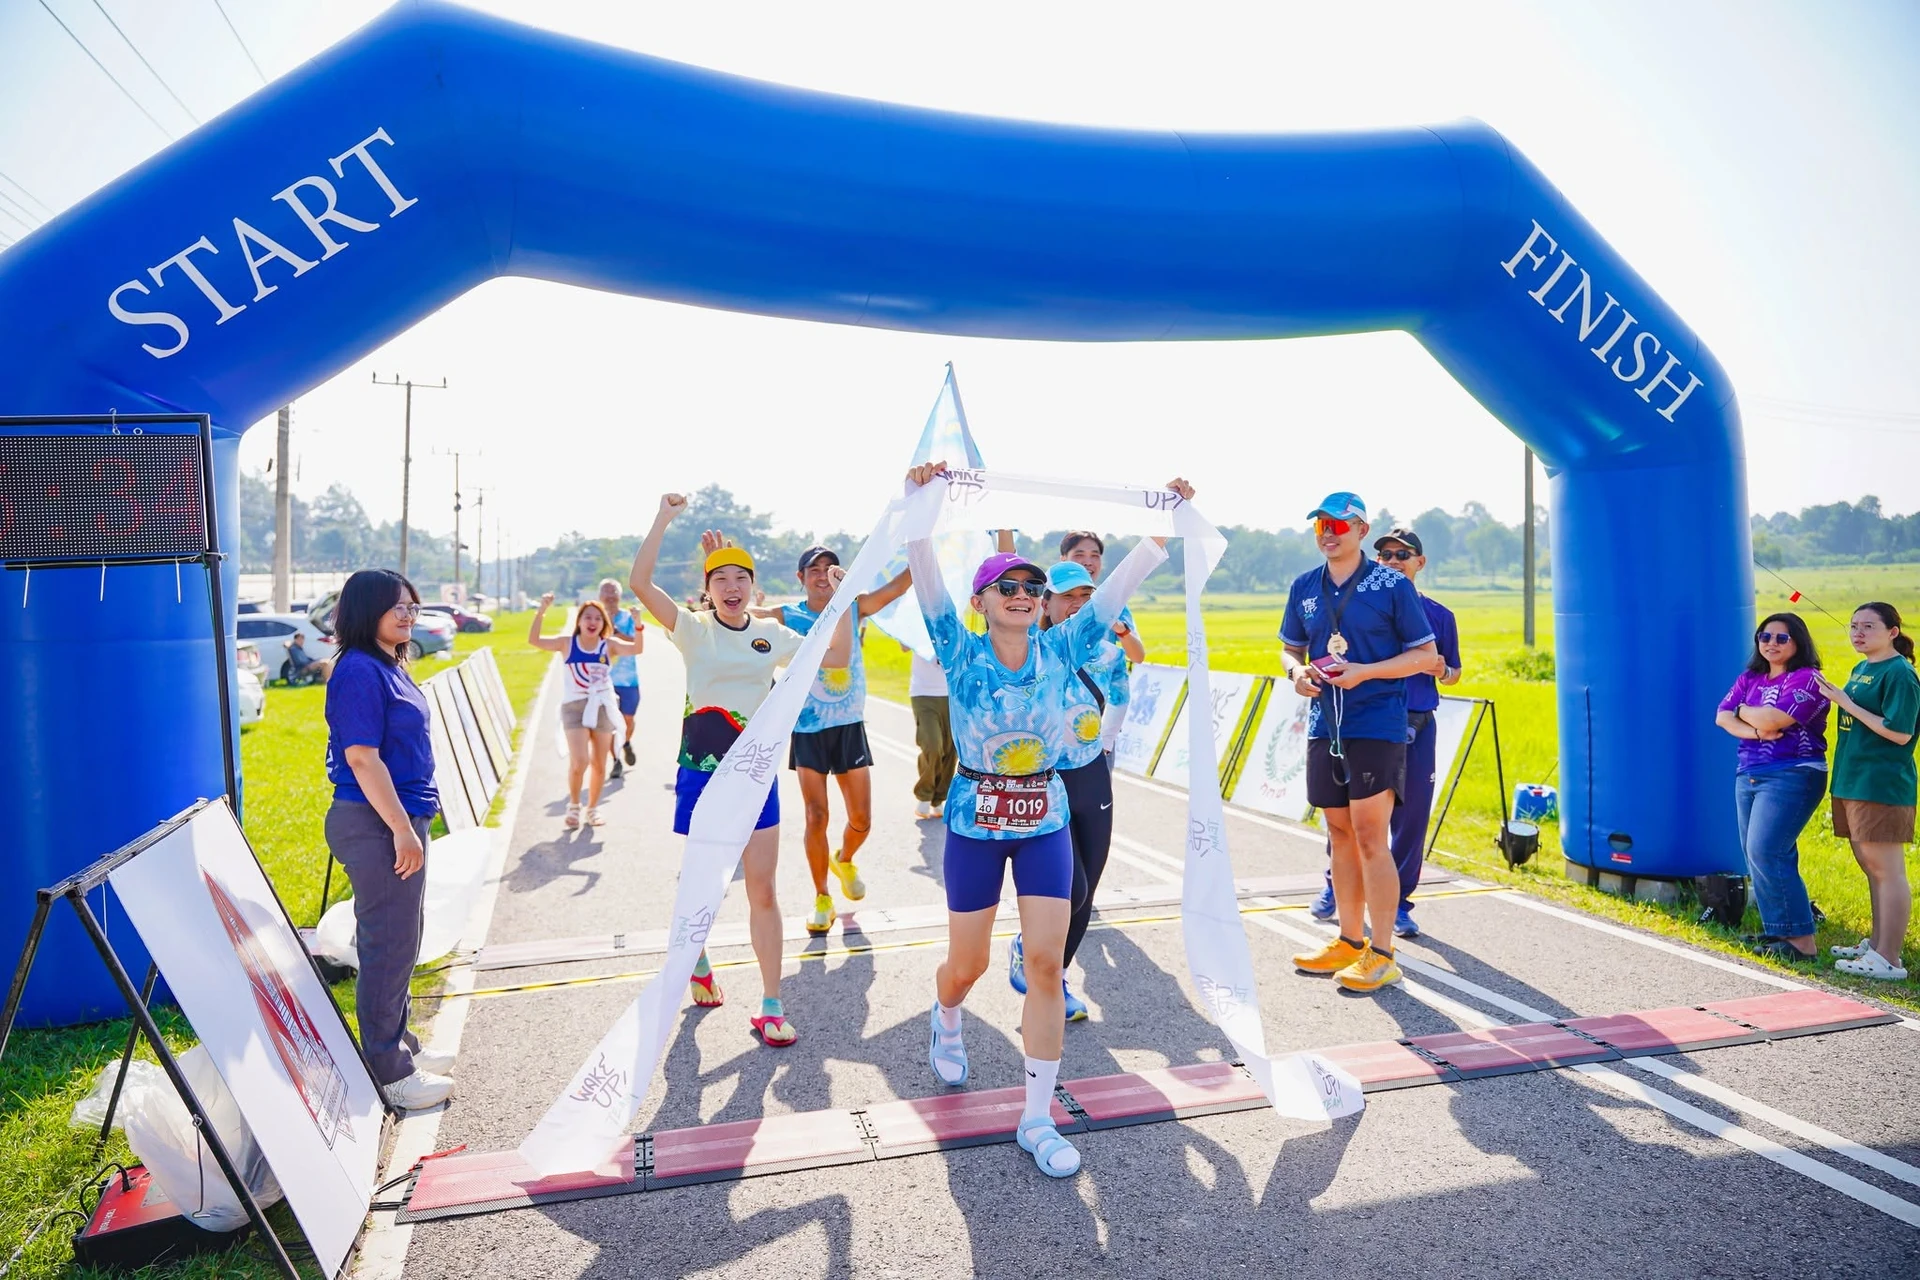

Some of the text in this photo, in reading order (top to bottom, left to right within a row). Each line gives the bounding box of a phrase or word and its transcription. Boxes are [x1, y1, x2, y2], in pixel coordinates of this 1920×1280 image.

[108, 126, 419, 359] START
[1500, 218, 1704, 423] FINISH
[0, 455, 202, 540] :34
[979, 805, 992, 813] 40
[1006, 798, 1044, 815] 1019
[569, 1052, 615, 1101] WAKE
[1322, 1095, 1344, 1111] TEAM
